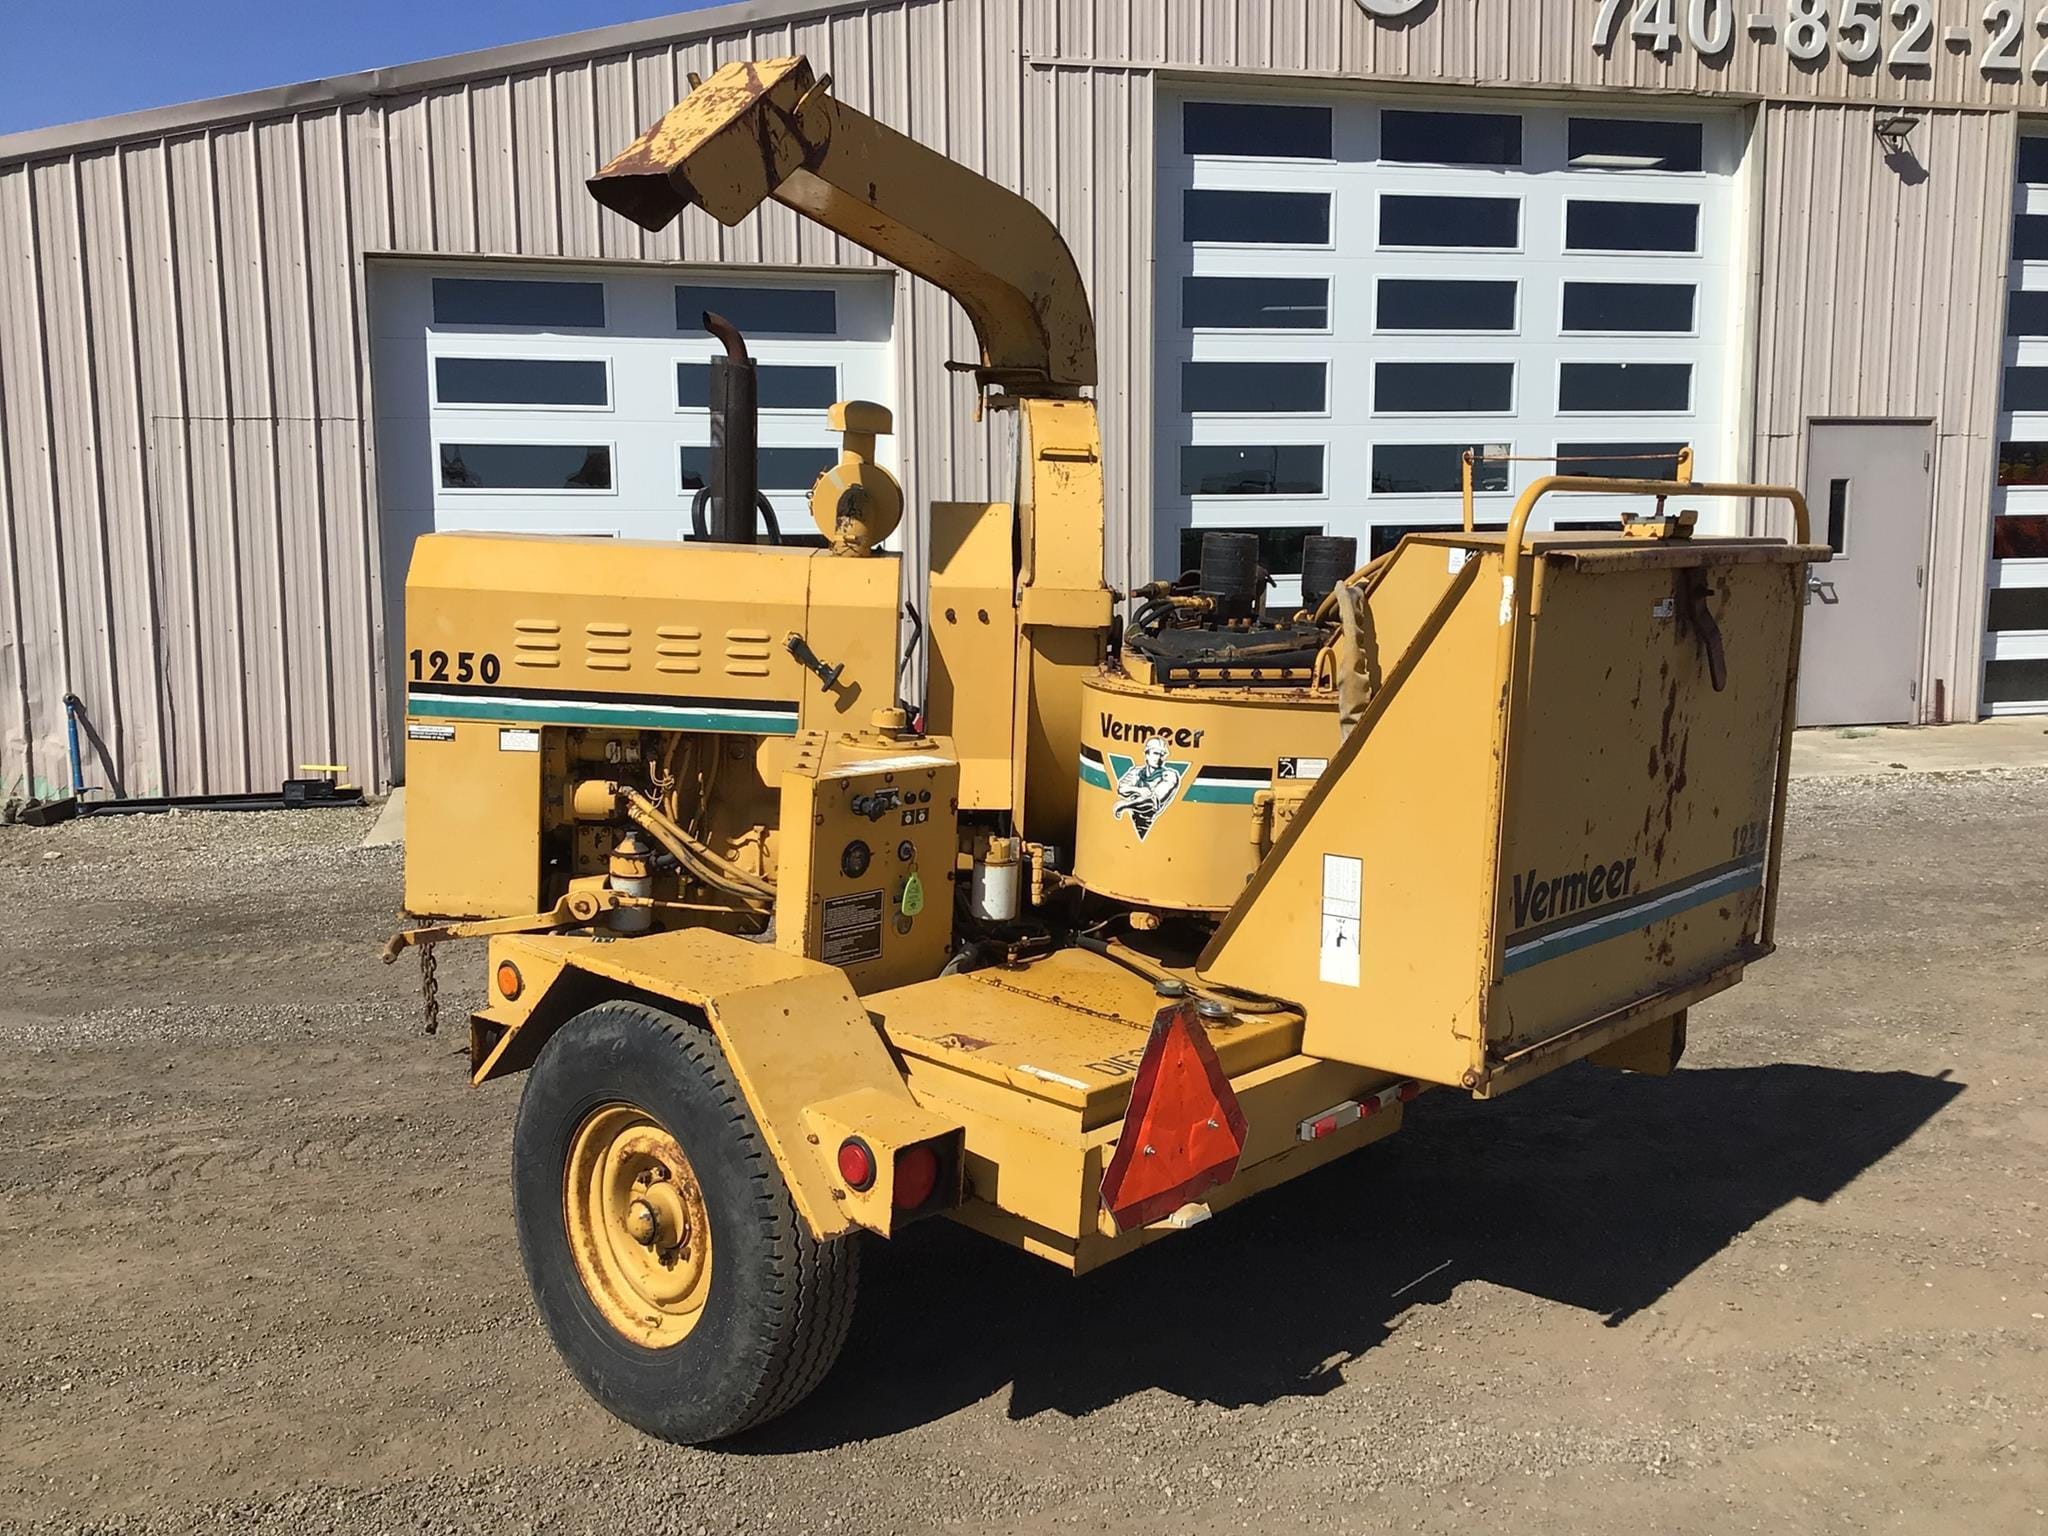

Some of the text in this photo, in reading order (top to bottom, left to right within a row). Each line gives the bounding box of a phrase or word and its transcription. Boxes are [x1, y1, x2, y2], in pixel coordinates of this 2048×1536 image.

[409, 649, 501, 684] 1250
[1100, 711, 1204, 749] Vermeer
[1513, 856, 1637, 929] Vermeer
